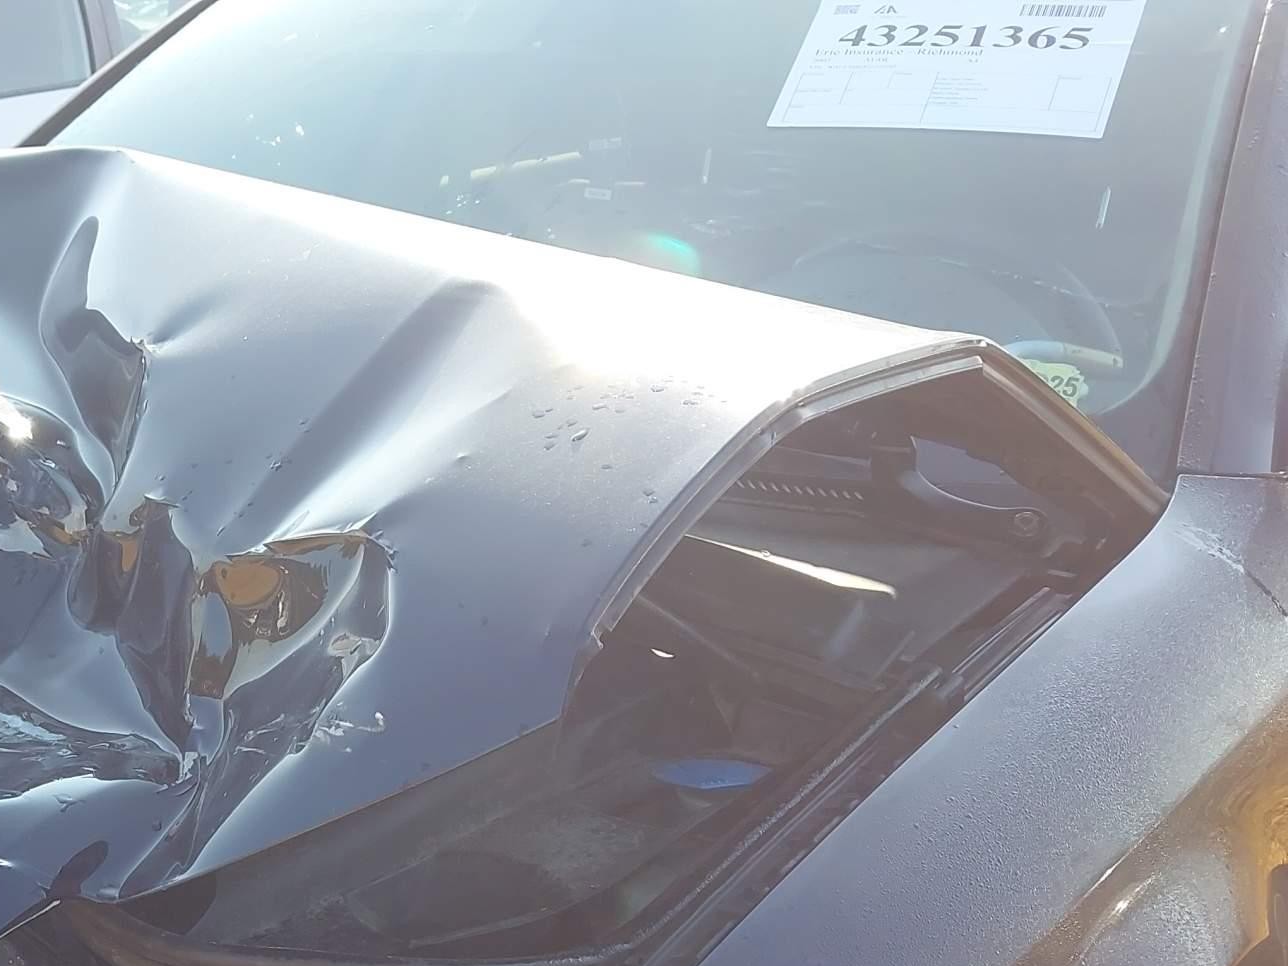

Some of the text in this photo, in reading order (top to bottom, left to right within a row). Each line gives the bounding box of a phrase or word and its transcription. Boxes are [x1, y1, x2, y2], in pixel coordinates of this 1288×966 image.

[839, 23, 1094, 49] 43251365
[843, 47, 904, 57] Insurance
[916, 47, 984, 57] Richmond
